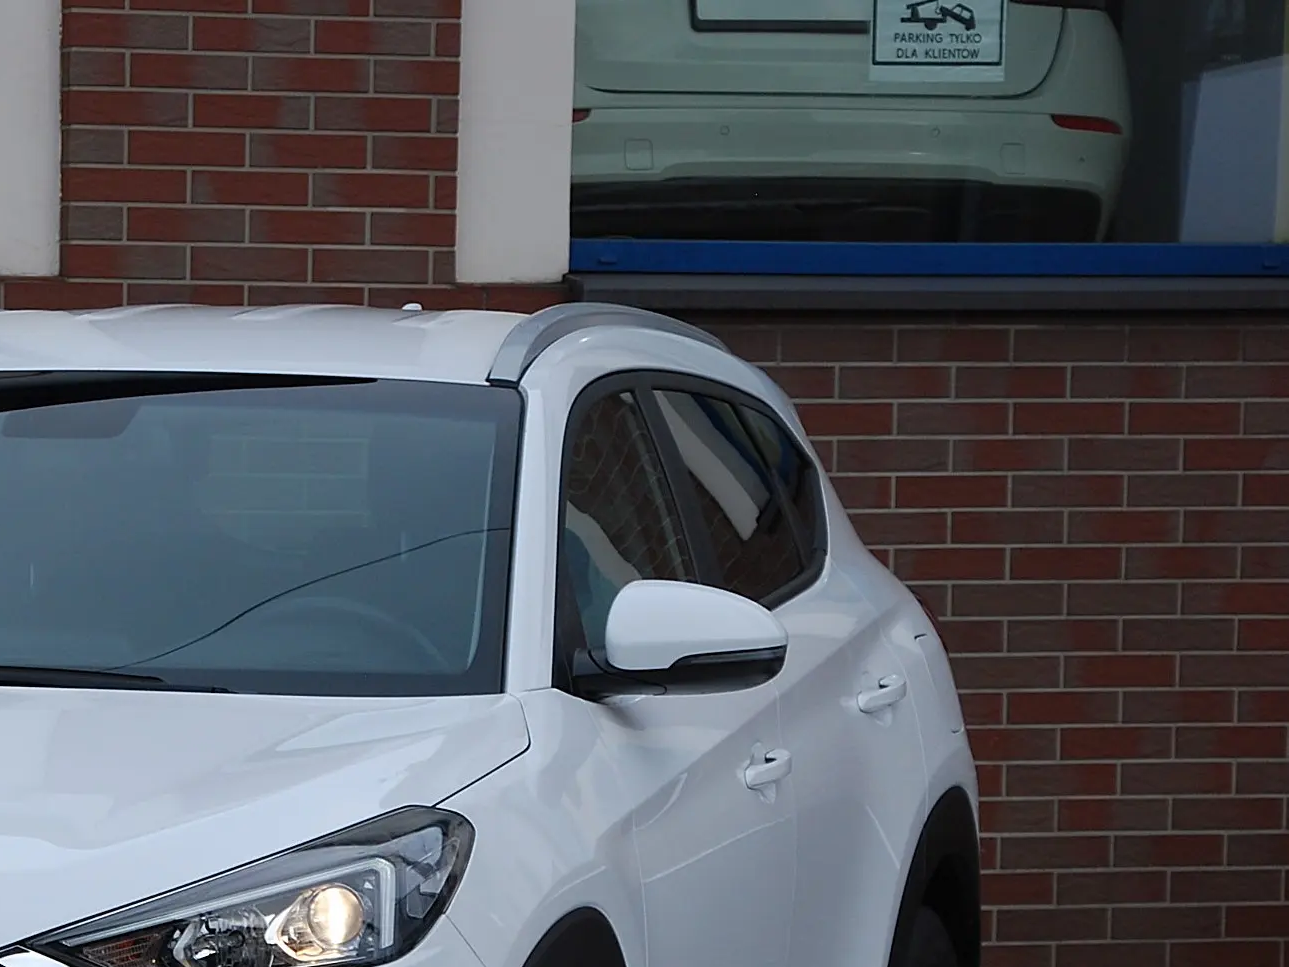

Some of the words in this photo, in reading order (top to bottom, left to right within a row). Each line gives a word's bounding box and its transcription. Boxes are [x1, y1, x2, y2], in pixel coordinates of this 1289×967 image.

[893, 32, 943, 44] PARKING
[949, 33, 982, 44] TYLKO
[896, 48, 918, 59] DLA
